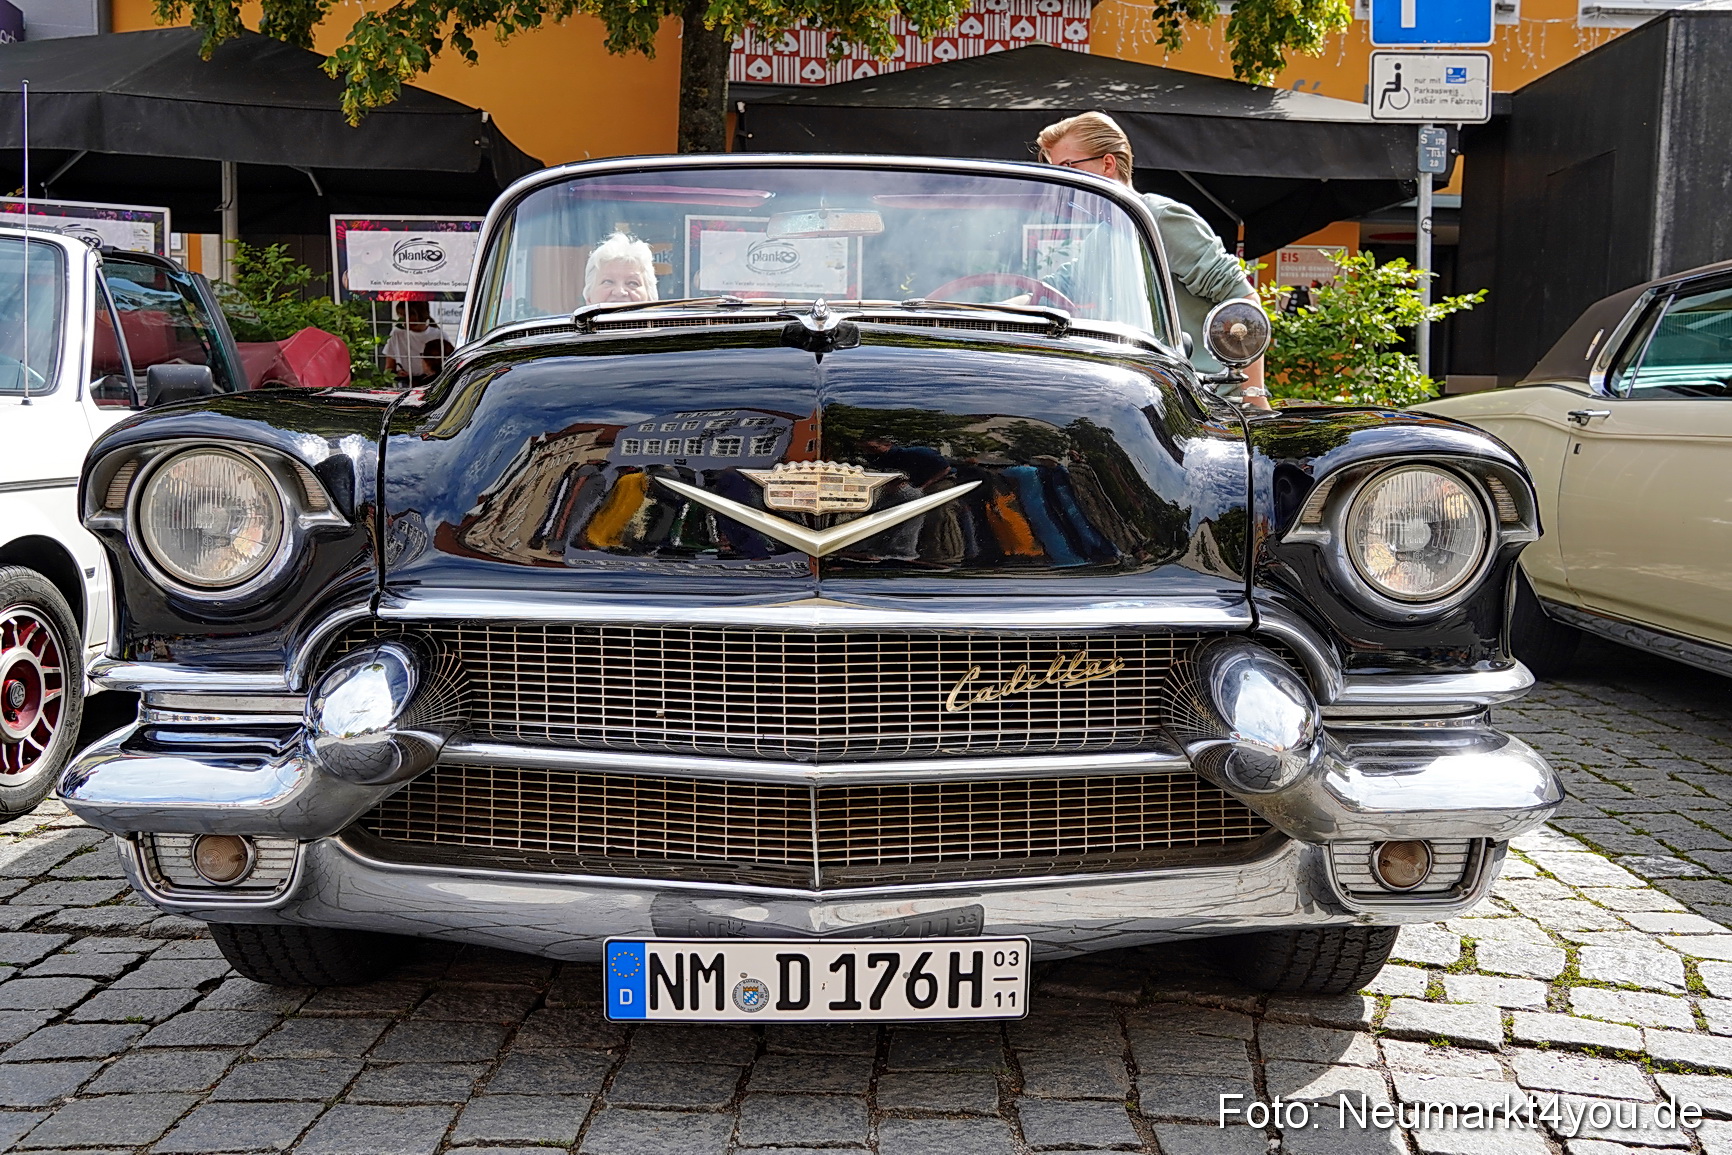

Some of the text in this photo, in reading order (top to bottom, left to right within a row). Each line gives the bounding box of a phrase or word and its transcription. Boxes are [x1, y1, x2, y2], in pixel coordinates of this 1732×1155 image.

[1420, 134, 1428, 144] S
[1281, 252, 1299, 262] EIS
[946, 650, 1126, 713] Cadillac
[993, 950, 1020, 967] 03
[649, 952, 725, 1011] NM
[776, 953, 811, 1010] D
[828, 951, 984, 1011] 176H
[619, 988, 633, 1005] D
[994, 991, 1016, 1008] 11
